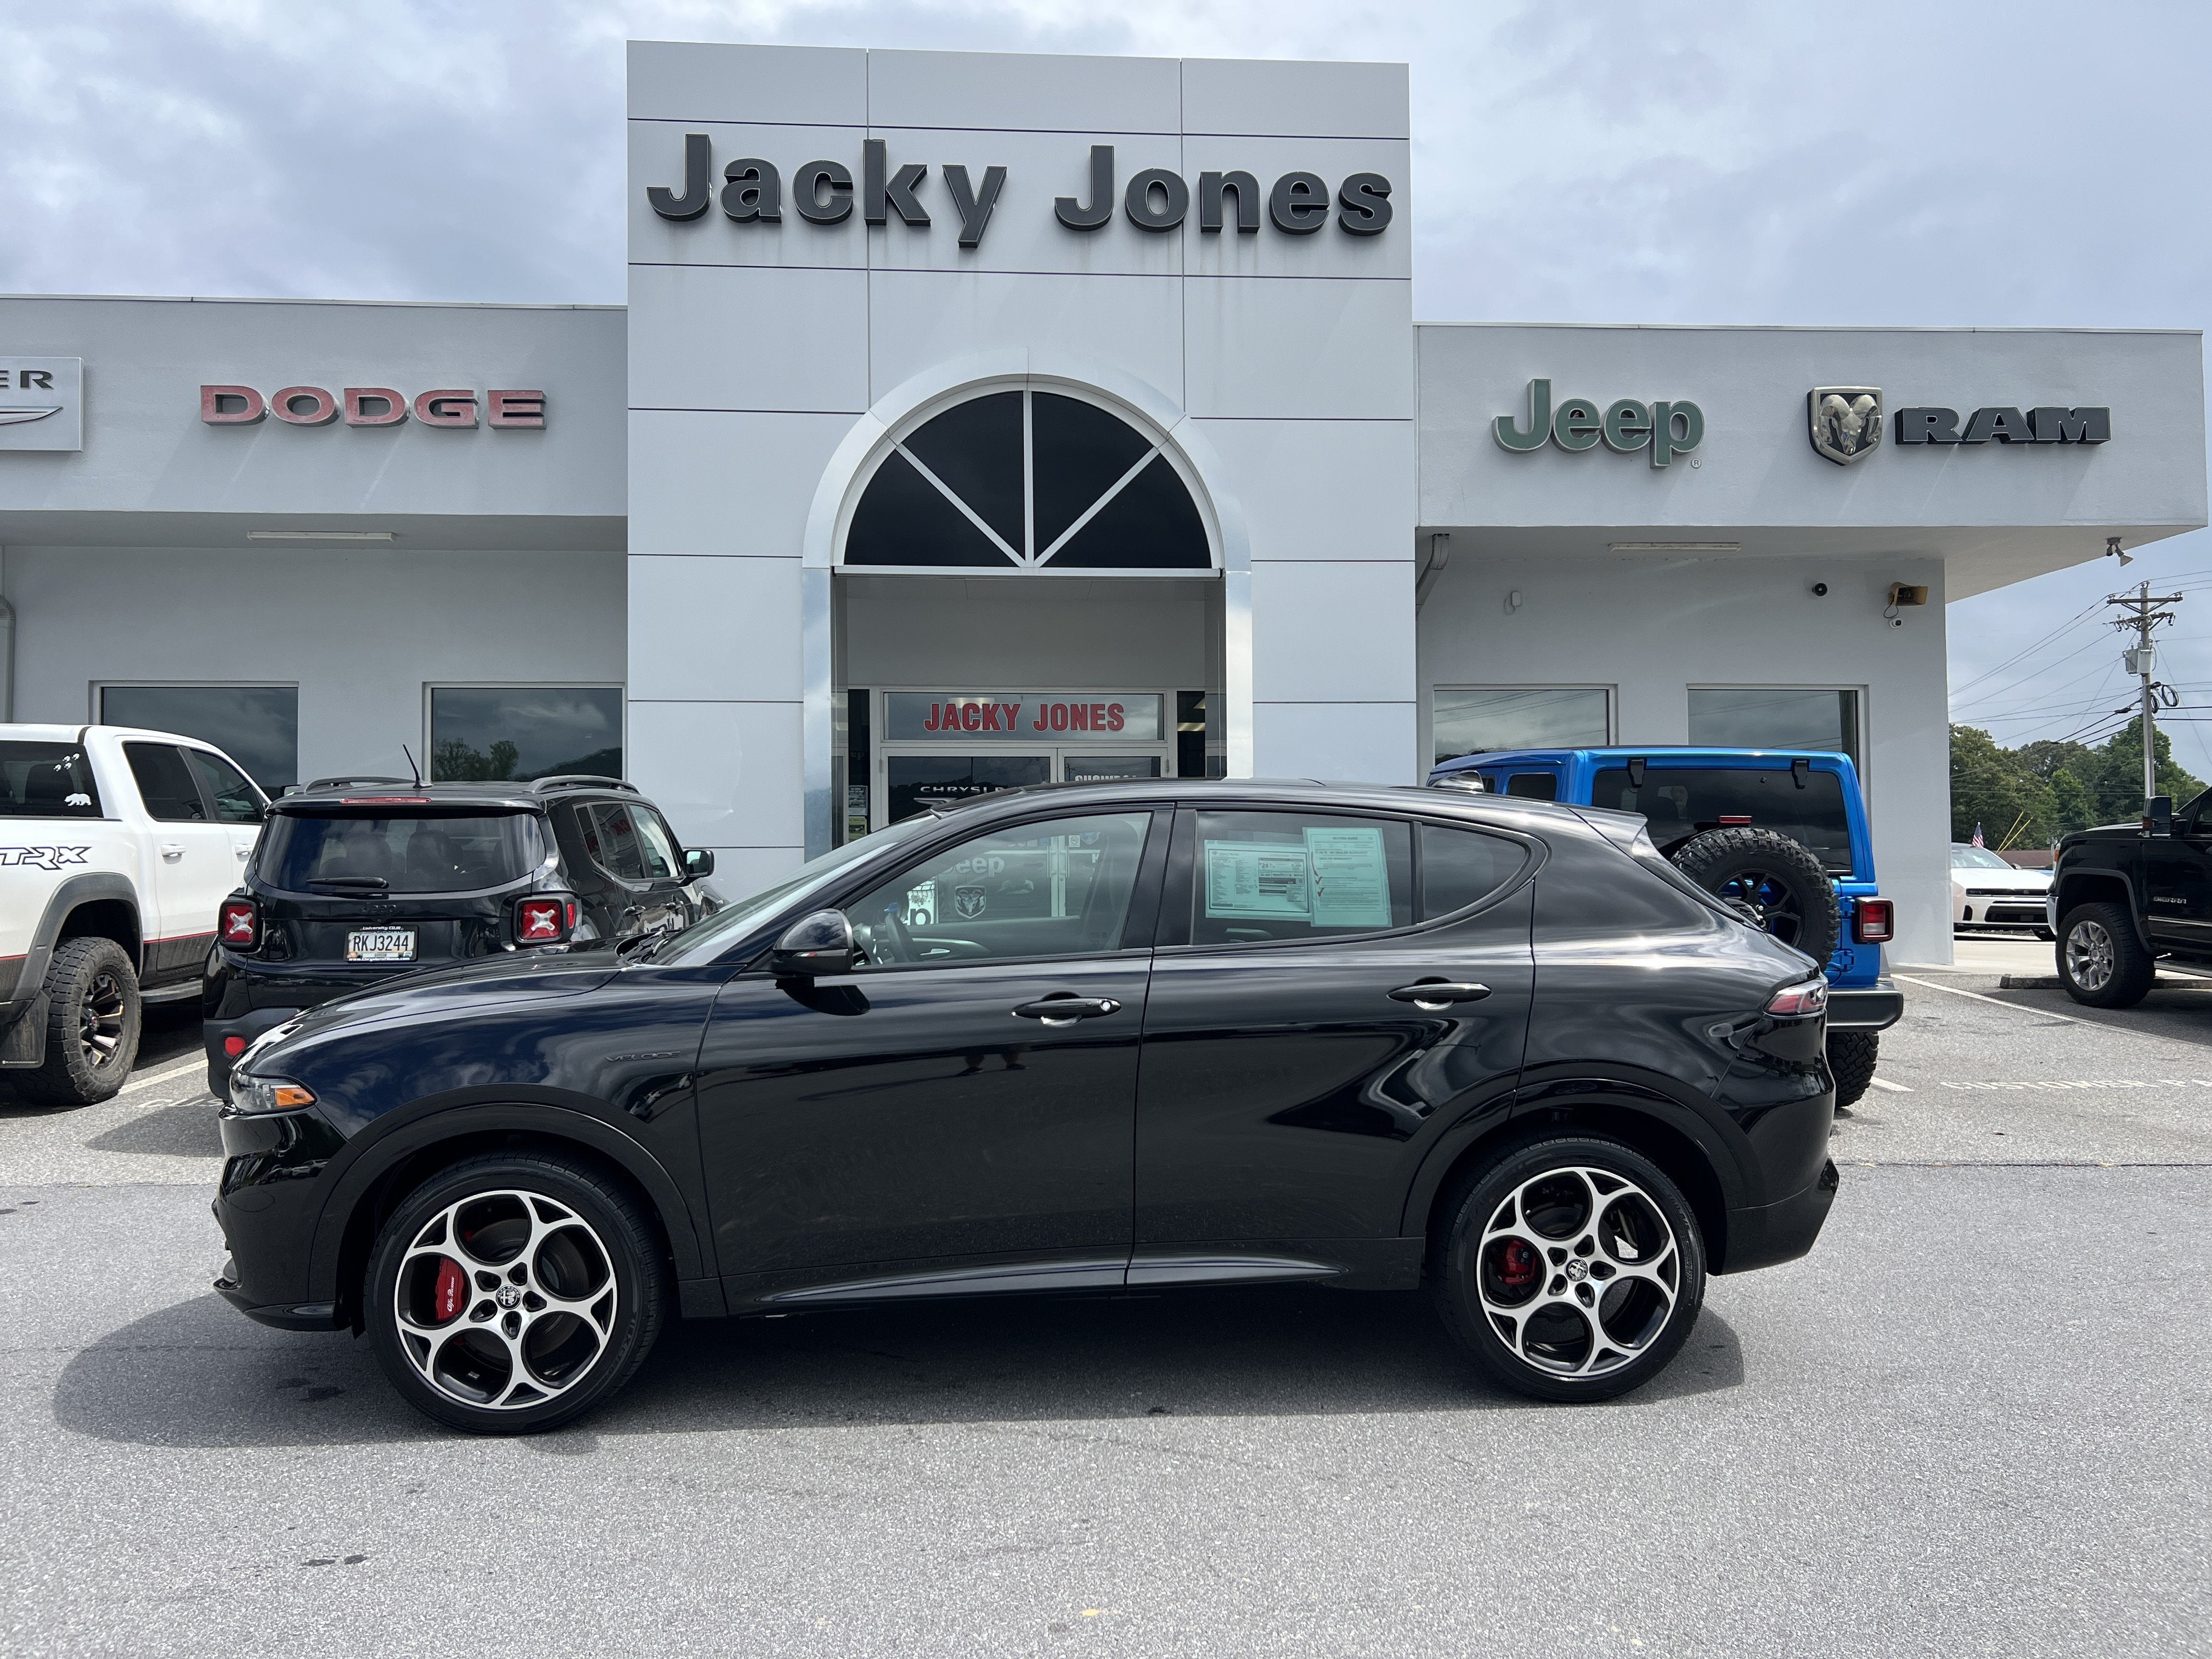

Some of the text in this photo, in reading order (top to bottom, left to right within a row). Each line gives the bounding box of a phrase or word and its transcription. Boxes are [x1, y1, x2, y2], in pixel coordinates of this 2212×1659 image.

[646, 133, 1393, 248] Jacky Jones
[200, 385, 546, 429] DODGE
[1492, 379, 1705, 469] Jeep
[1894, 407, 2111, 445] RAM
[924, 702, 1125, 731] JACKY JONES
[0, 847, 93, 870] TRX
[353, 935, 409, 951] RKJ3244
[605, 1051, 681, 1062] VELOCE
